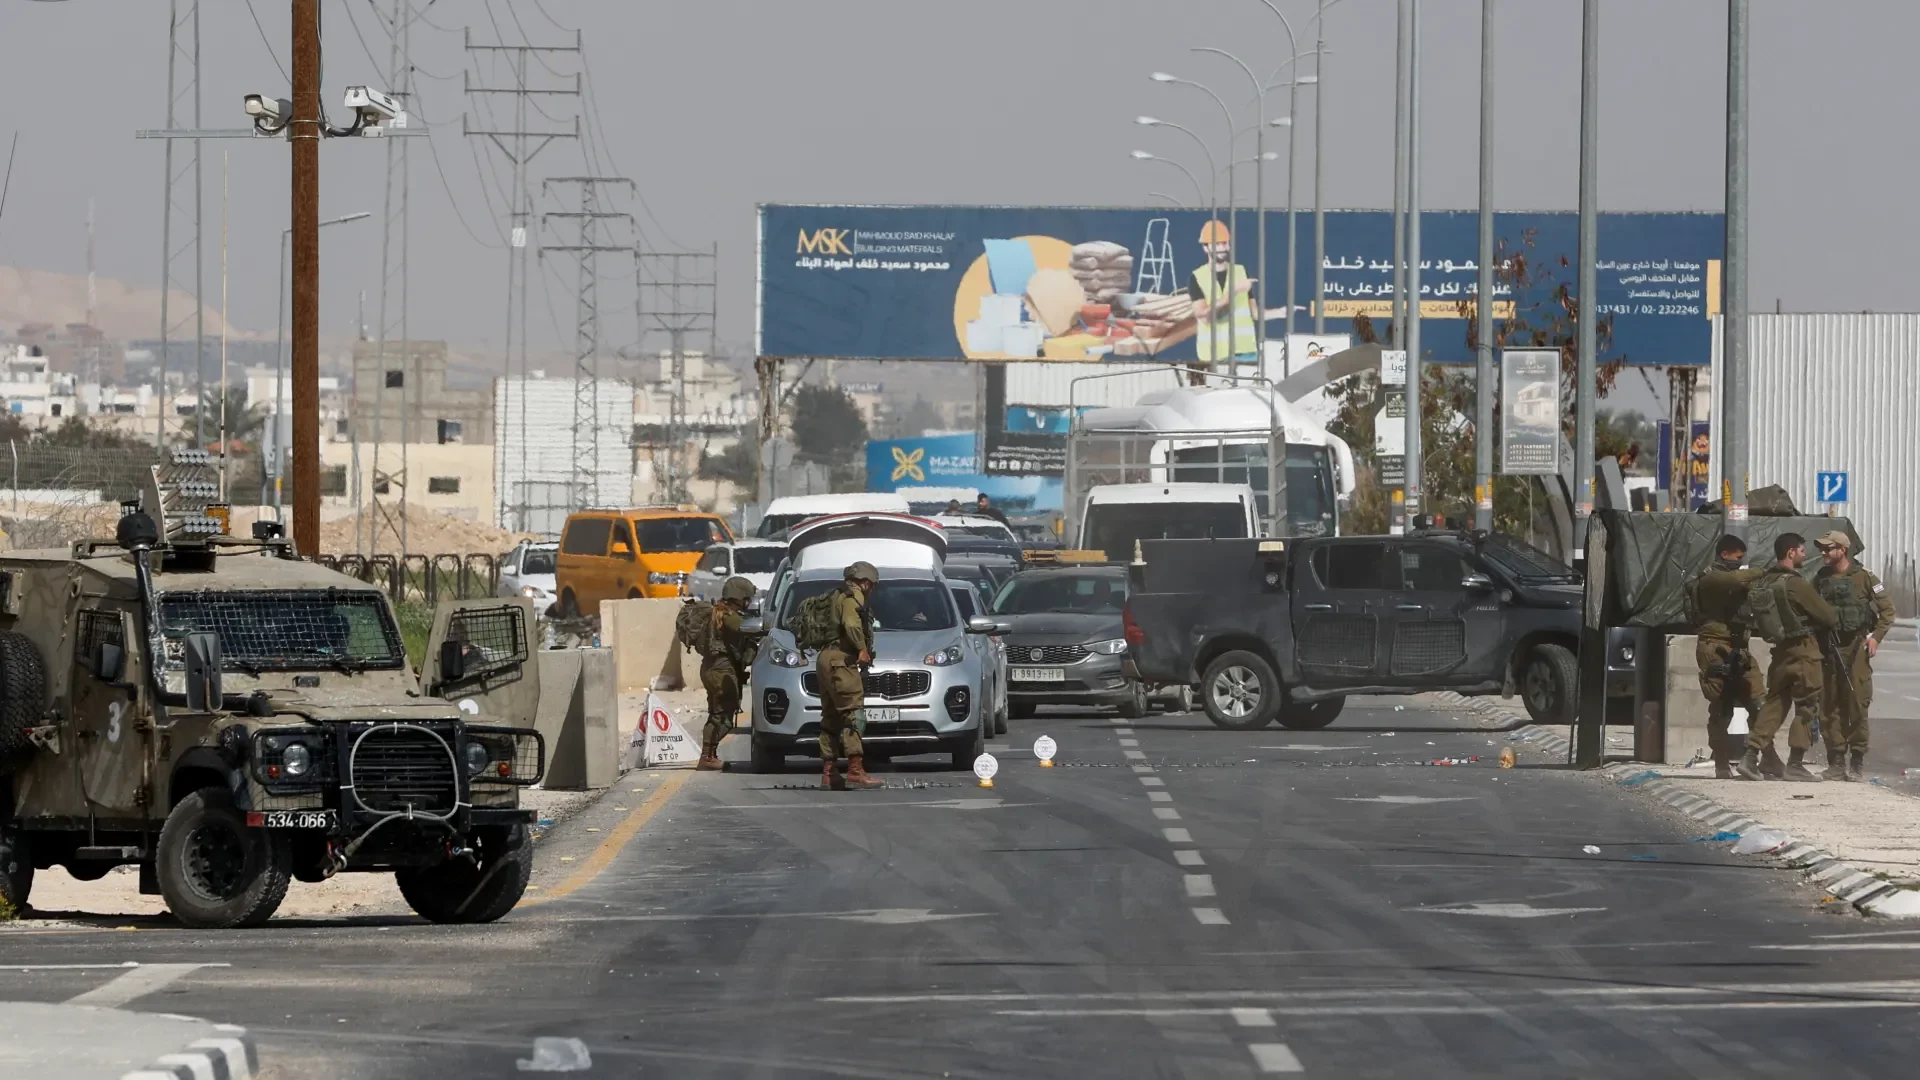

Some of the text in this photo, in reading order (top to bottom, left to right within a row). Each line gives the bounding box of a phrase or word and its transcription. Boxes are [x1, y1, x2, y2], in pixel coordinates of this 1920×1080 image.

[796, 228, 852, 255] MSK
[904, 232, 922, 240] SAID
[924, 232, 956, 240] KHALAF
[856, 244, 943, 253] BUILDING MATERIALS
[795, 257, 950, 272] محمود سعيد خلف لمواد البناء
[1348, 282, 1373, 297] على
[1658, 304, 1700, 315] 2322246
[107, 701, 122, 743] 3
[657, 753, 679, 761] STOP
